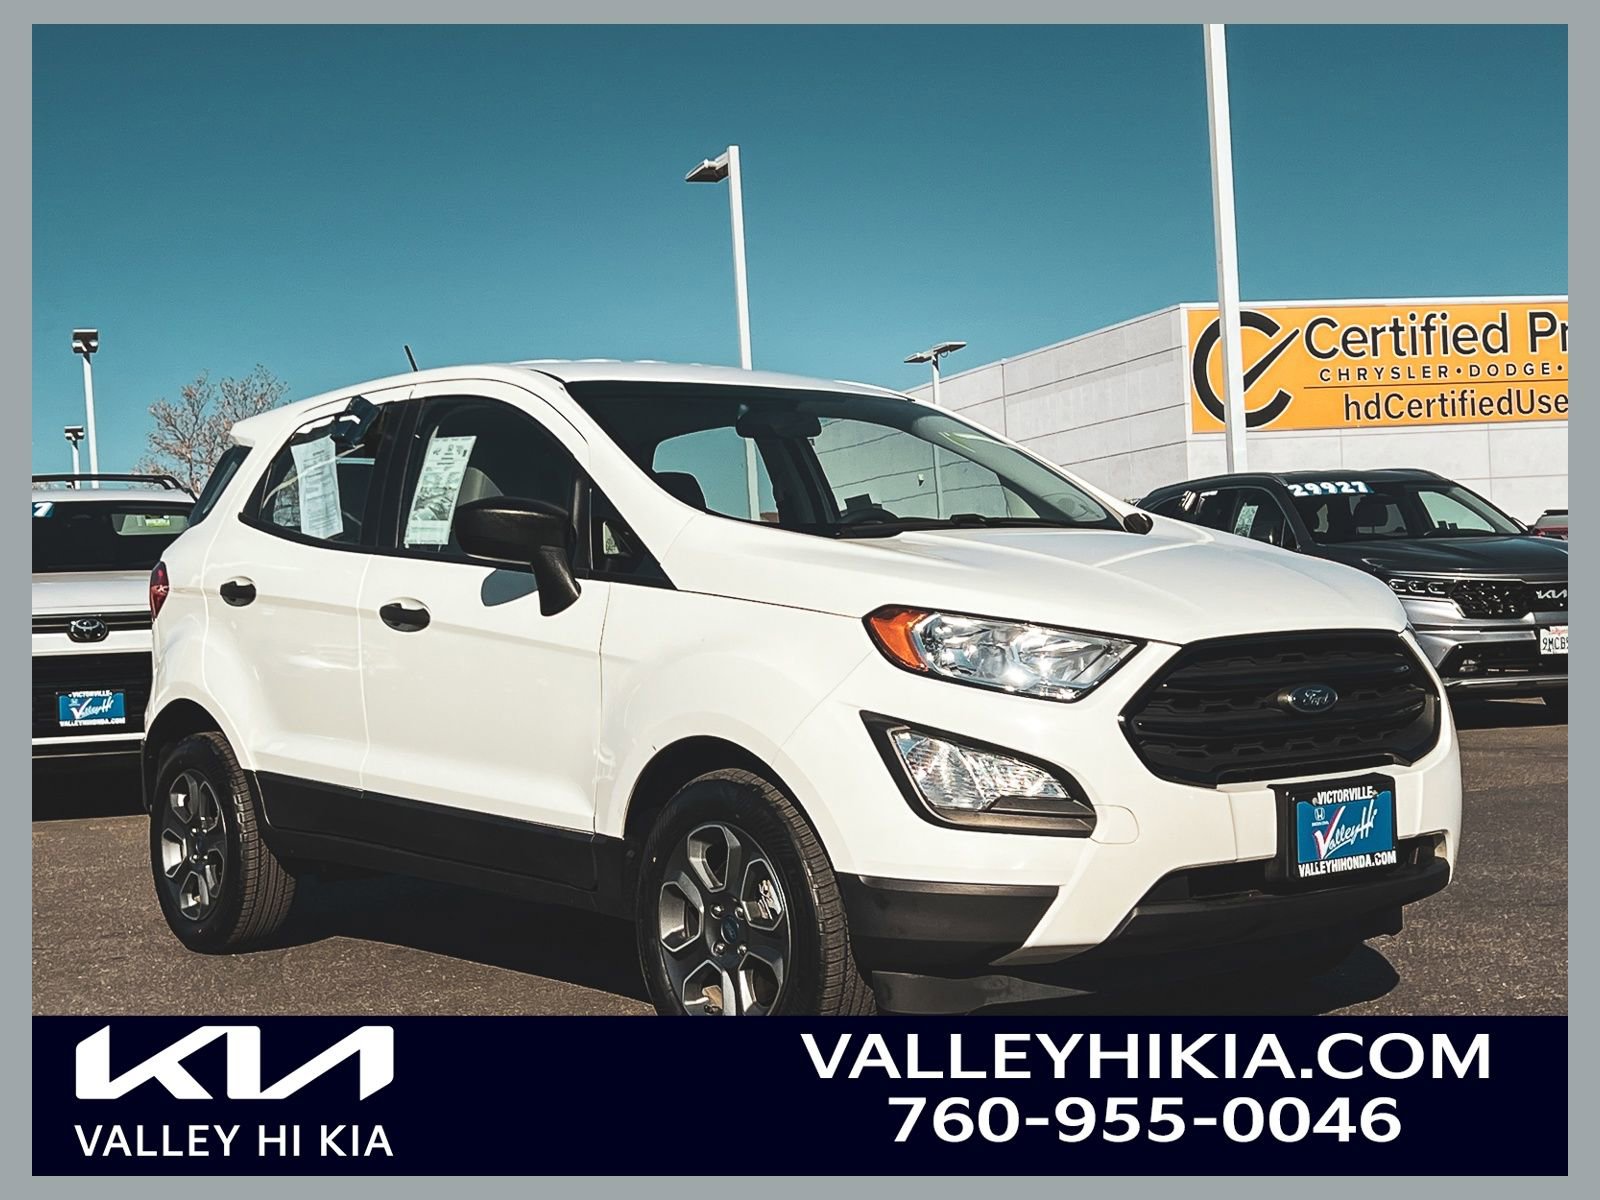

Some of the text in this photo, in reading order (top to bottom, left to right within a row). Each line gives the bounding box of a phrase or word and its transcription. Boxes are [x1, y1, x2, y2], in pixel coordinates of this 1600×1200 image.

[1304, 312, 1508, 359] Certified
[1344, 388, 1568, 421] hdCertifiedUse
[1287, 481, 1369, 497] 29927
[1316, 785, 1374, 805] VICTORVILLE
[1298, 850, 1397, 878] VALLEYHIHONDA.COM
